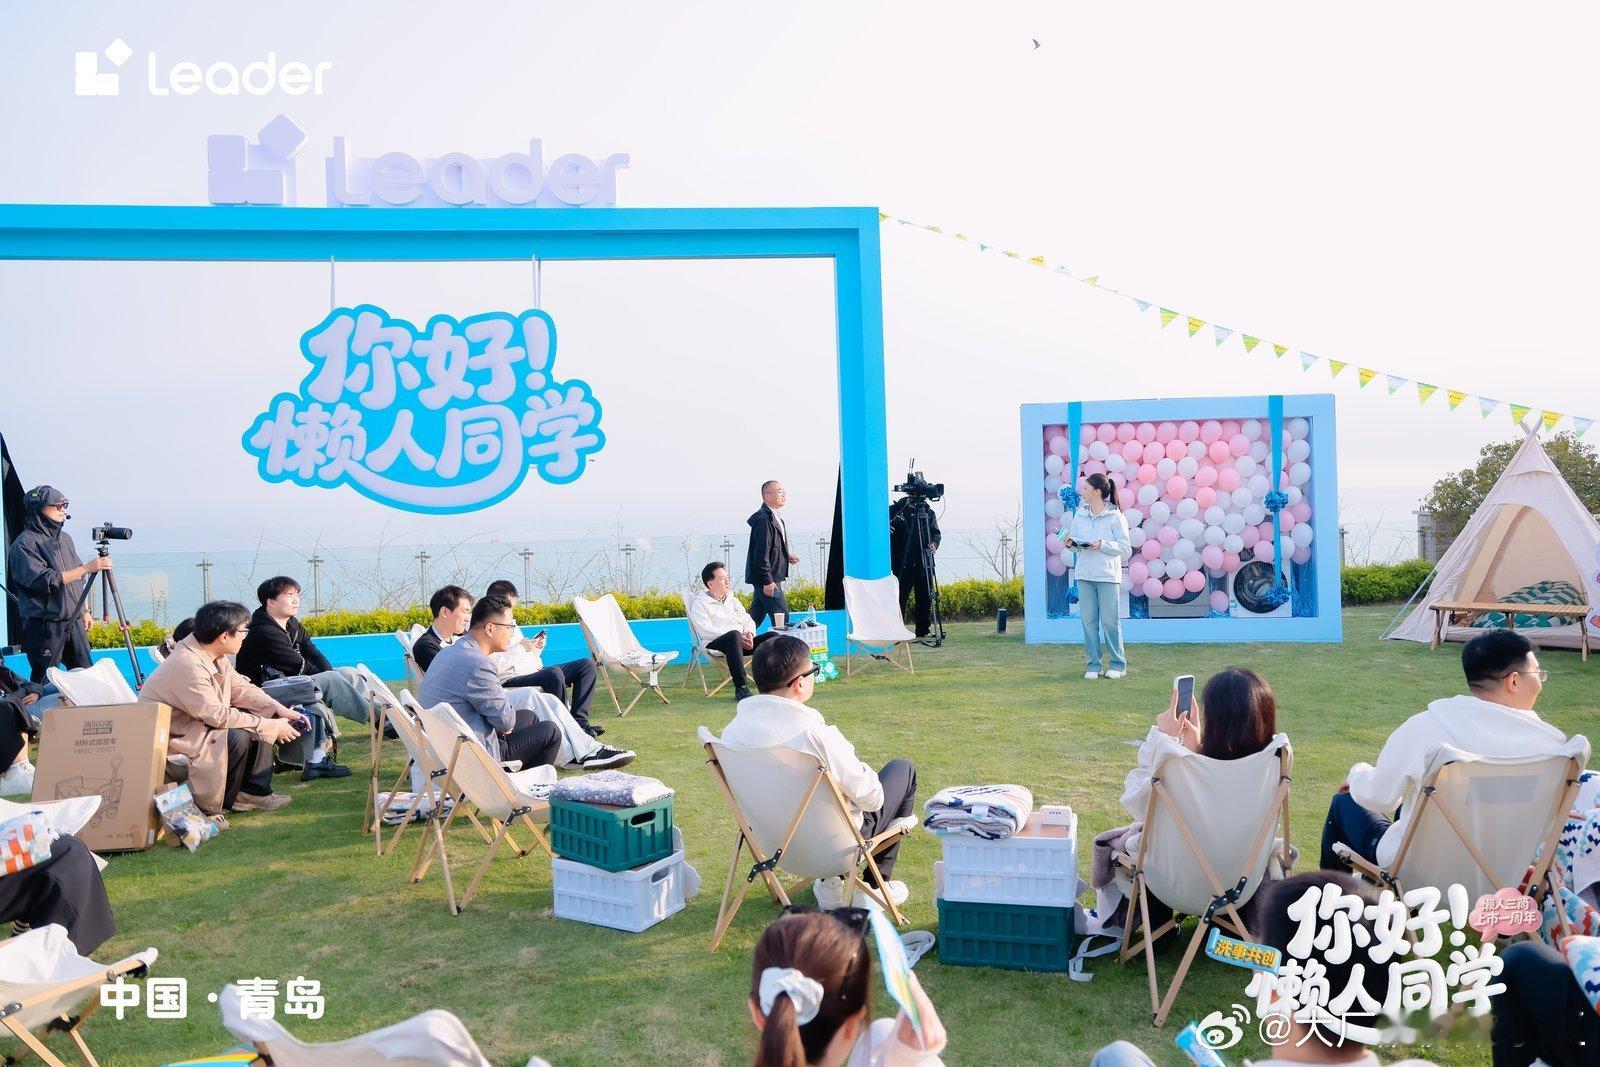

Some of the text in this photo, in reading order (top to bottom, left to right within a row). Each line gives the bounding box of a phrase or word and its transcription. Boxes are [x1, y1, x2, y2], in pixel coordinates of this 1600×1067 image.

[331, 136, 632, 206] Leader
[307, 310, 551, 410] 你好！
[250, 385, 599, 501] 懒人同学
